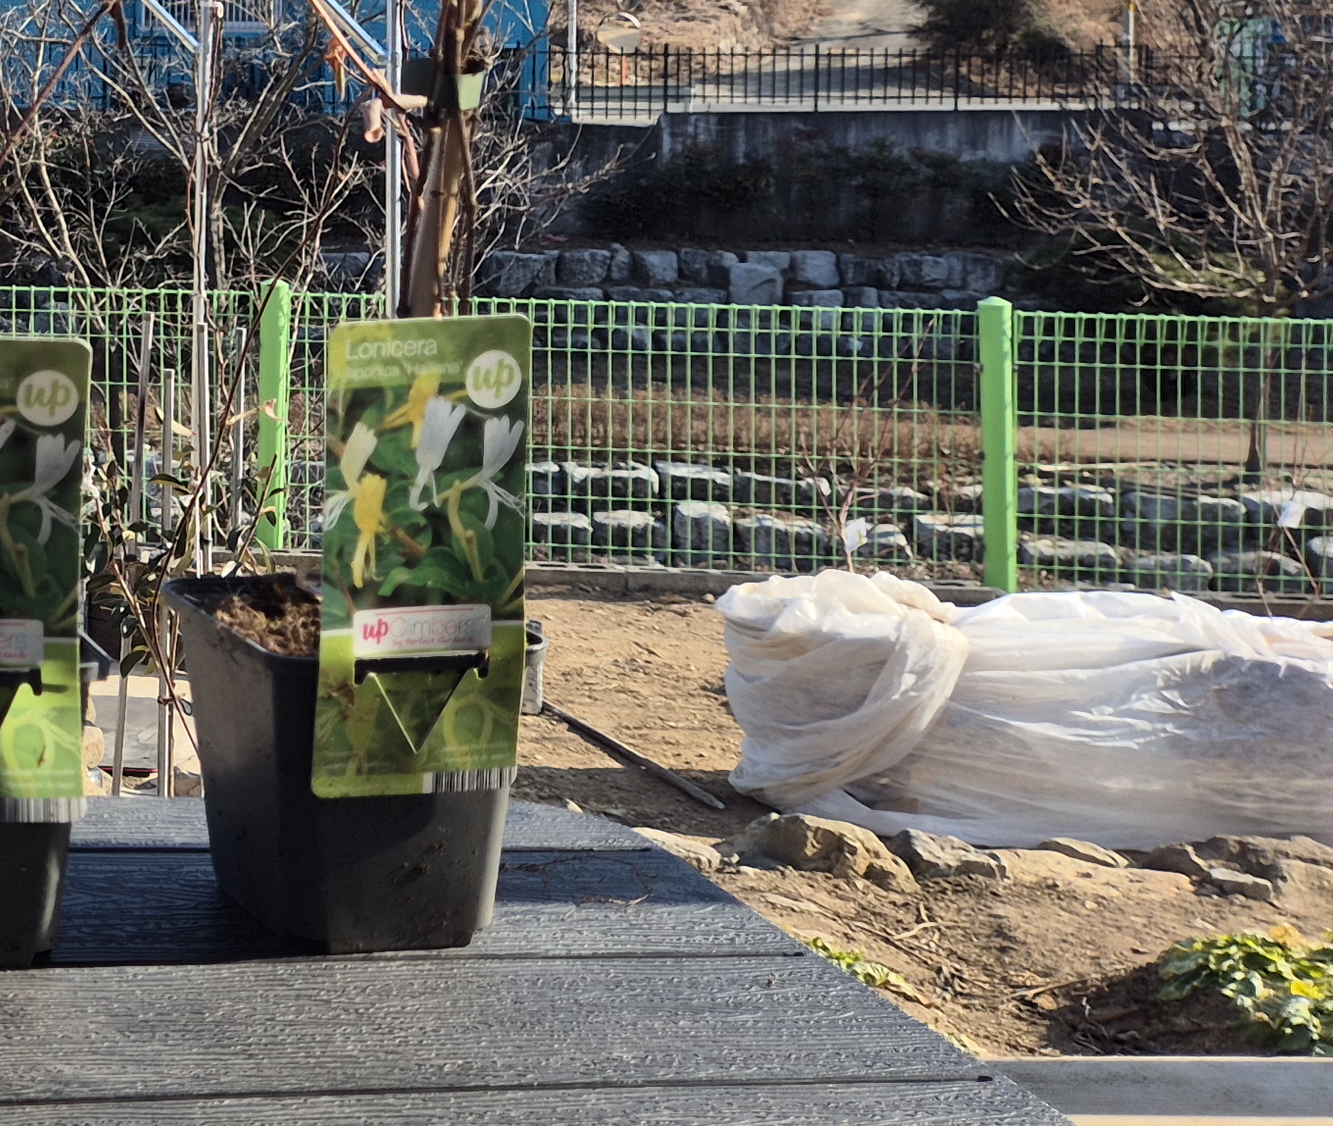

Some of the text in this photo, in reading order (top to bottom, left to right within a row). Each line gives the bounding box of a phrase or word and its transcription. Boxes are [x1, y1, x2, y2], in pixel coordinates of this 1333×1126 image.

[346, 338, 438, 360] Lonicera
[23, 378, 73, 418] up
[471, 358, 515, 400] up
